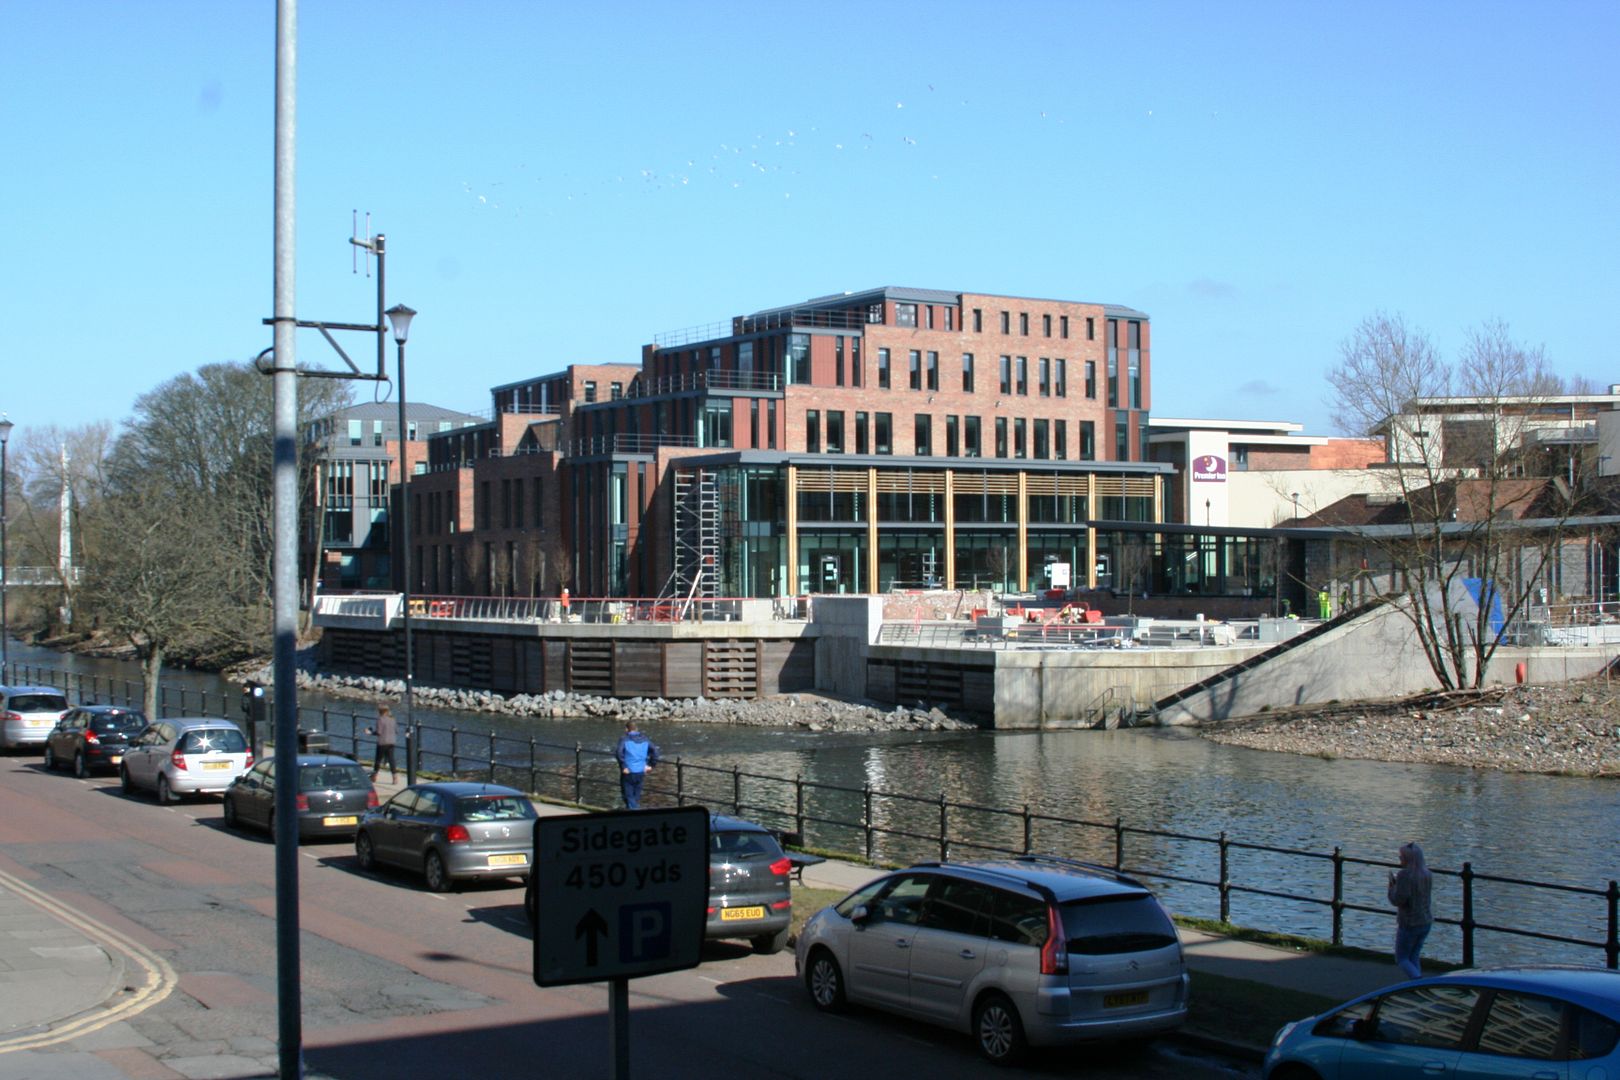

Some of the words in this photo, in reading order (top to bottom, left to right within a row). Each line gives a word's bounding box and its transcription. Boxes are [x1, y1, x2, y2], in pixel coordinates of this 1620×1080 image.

[561, 821, 688, 853] Sidegate
[565, 862, 627, 890] 450
[634, 859, 681, 890] yds
[632, 909, 663, 957] P
